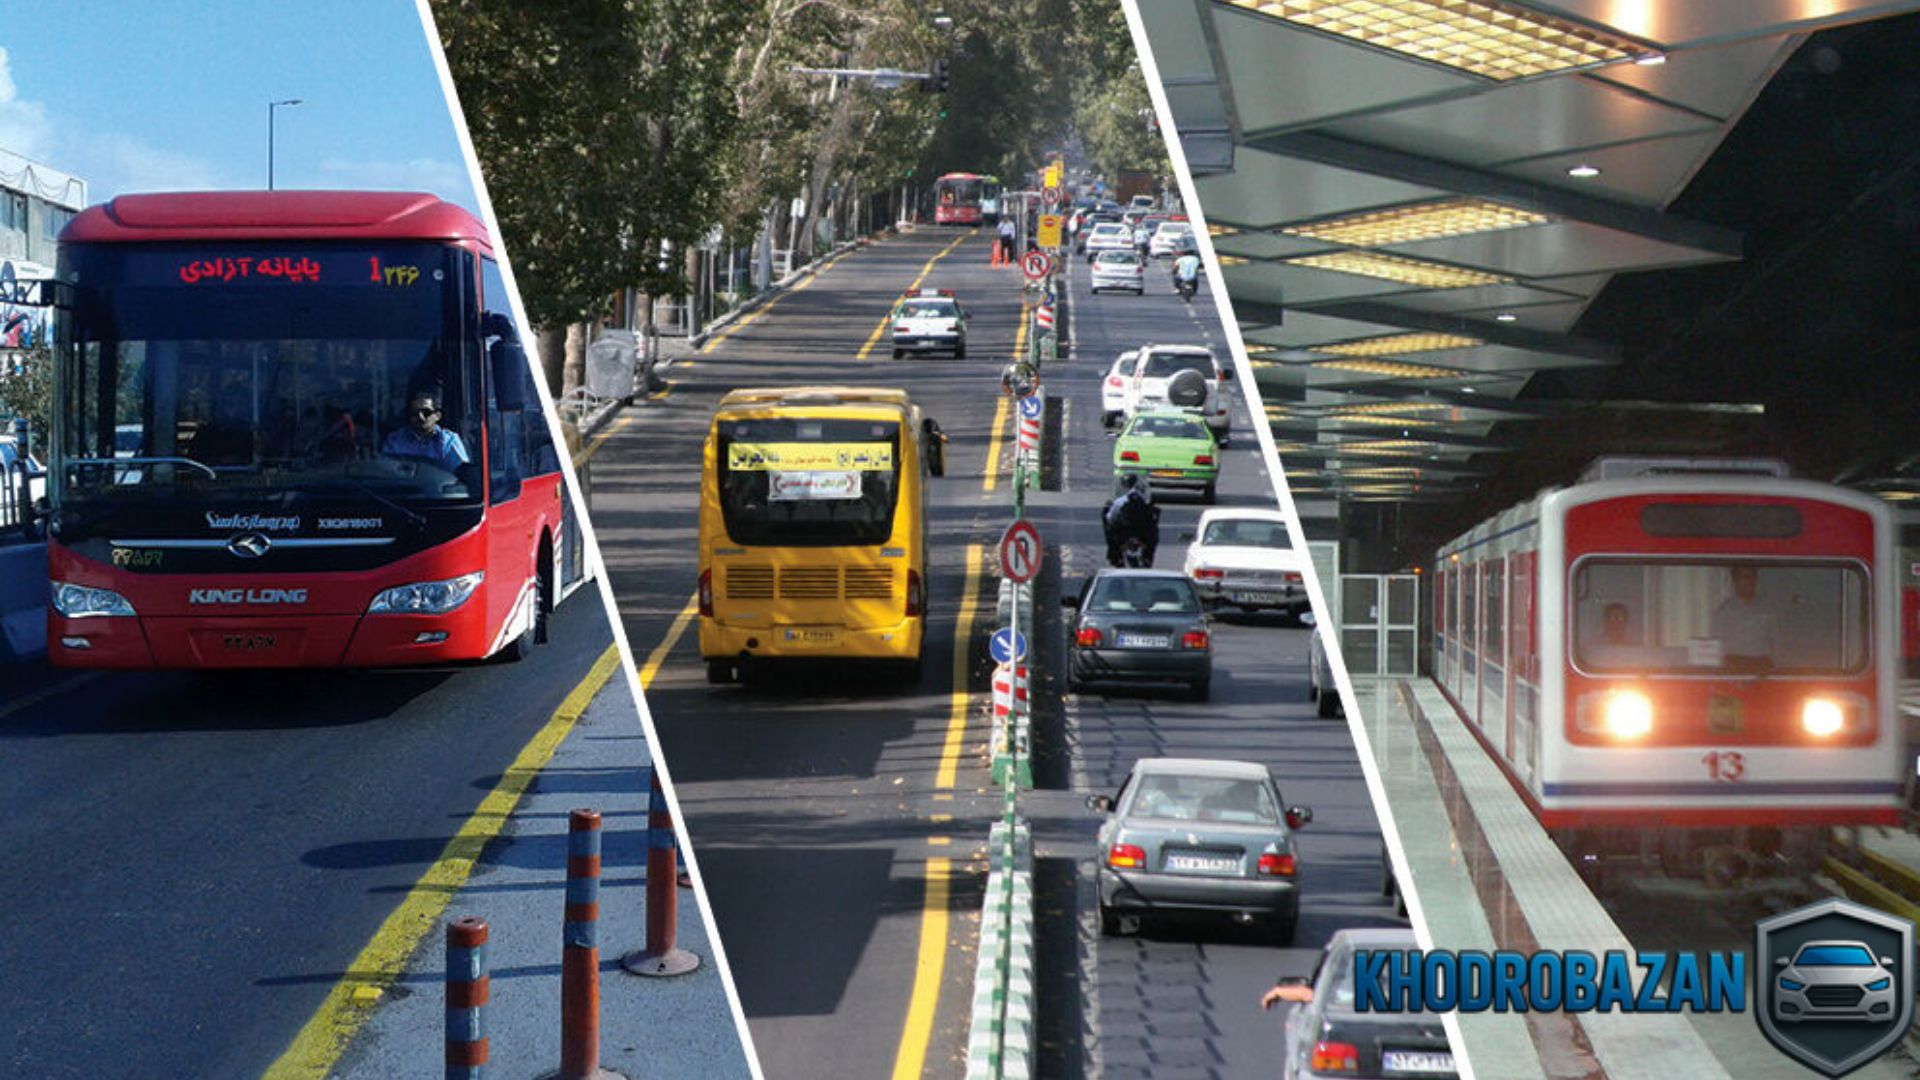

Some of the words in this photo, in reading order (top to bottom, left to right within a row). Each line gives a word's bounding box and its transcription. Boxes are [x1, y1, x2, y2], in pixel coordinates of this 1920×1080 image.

[180, 257, 253, 283] آزادی
[256, 257, 321, 282] پایانه
[189, 588, 244, 604] KING
[246, 588, 308, 604] LONG
[1701, 751, 1745, 783] 13
